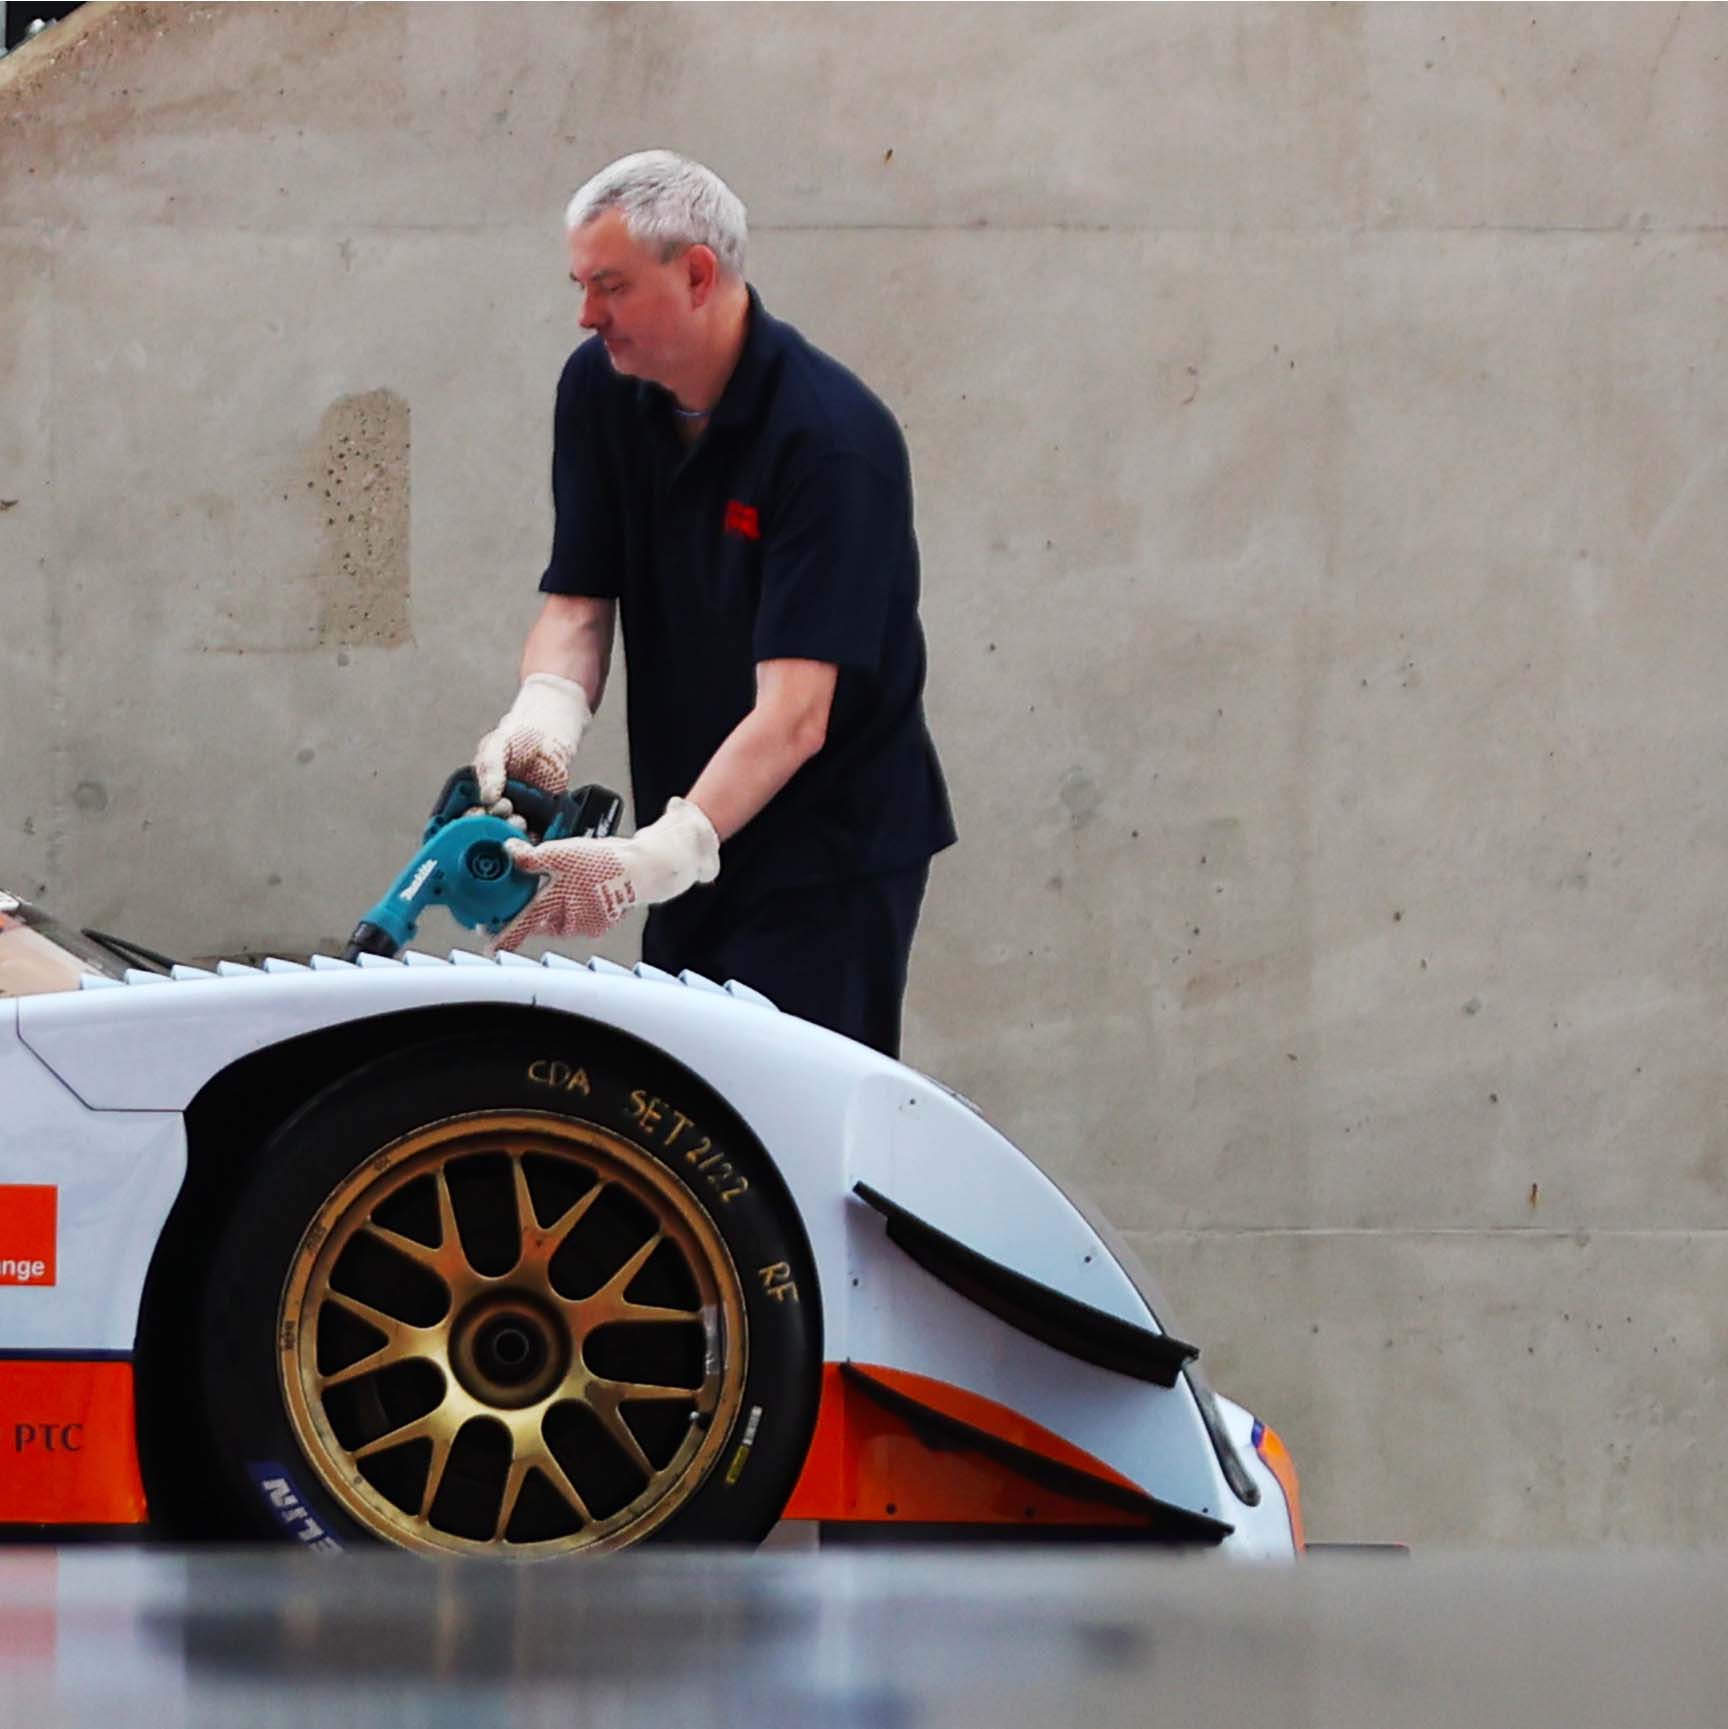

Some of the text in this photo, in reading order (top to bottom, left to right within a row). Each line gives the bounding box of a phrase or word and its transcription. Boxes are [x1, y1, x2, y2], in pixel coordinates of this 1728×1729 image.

[528, 1060, 800, 1303] CDA SET 2/22 RF
[15, 1424, 84, 1453] PTC
